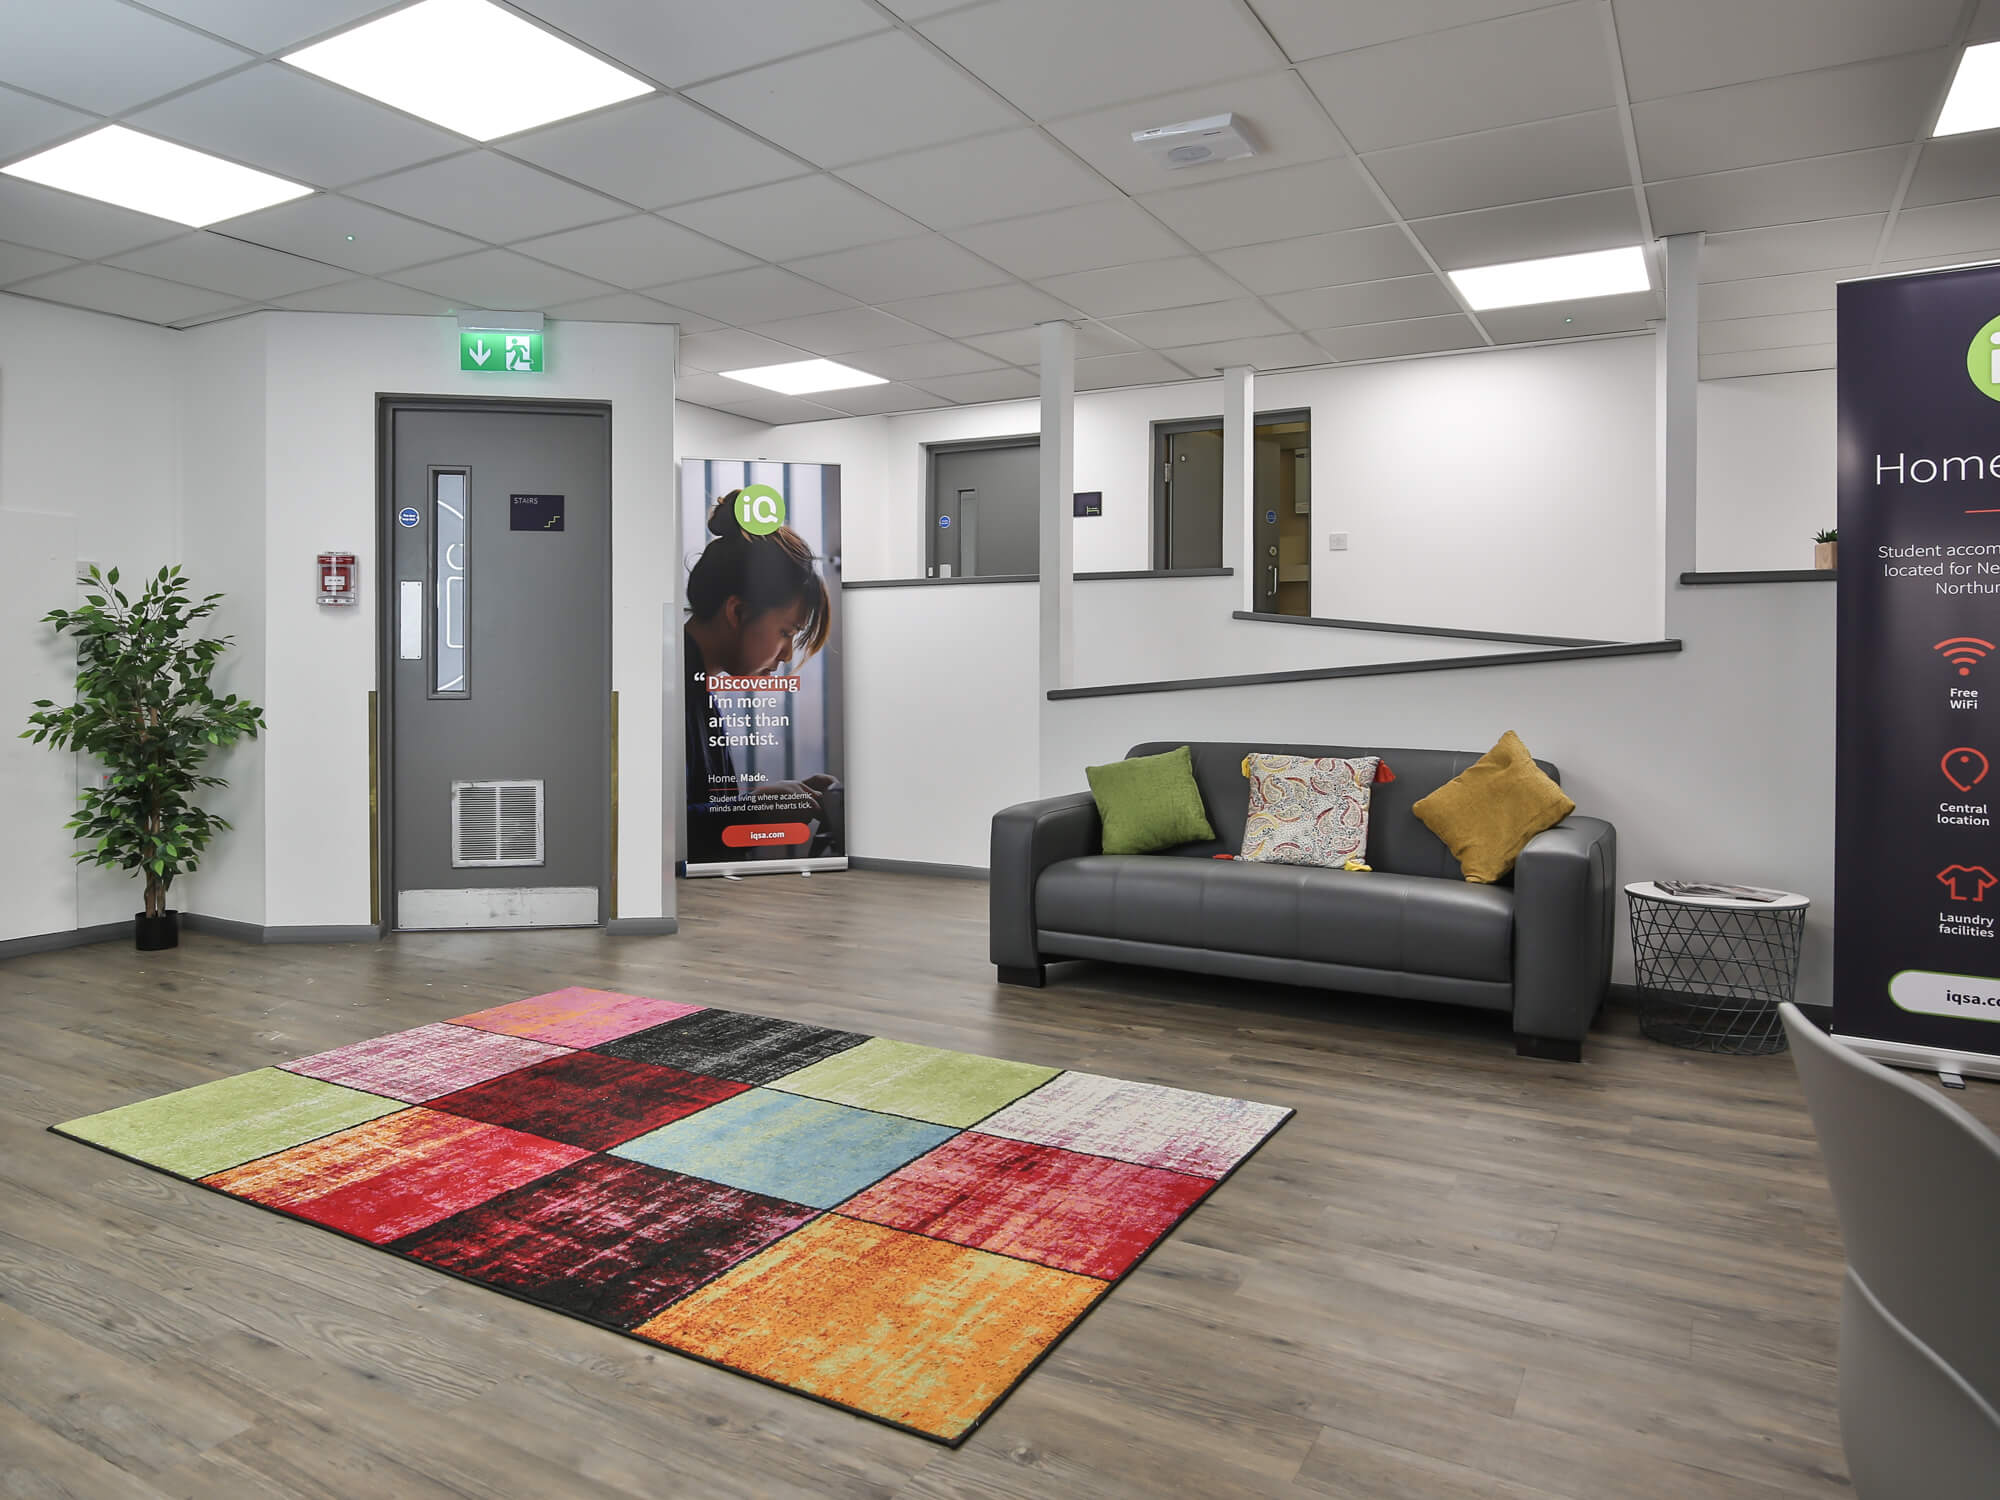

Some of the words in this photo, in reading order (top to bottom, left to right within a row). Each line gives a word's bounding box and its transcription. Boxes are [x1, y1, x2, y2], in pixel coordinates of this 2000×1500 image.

[743, 495, 778, 523] iQ
[1878, 544, 1941, 558] Student
[1884, 562, 1943, 577] located
[1949, 561, 1972, 575] for
[1950, 688, 1978, 697] Free
[737, 697, 777, 708] more
[1950, 699, 1978, 709] WiFi
[709, 713, 751, 727] artist
[755, 712, 789, 726] than
[709, 732, 779, 747] scientist.
[740, 773, 769, 782] Made.
[709, 795, 737, 803] Student
[738, 793, 756, 803] living
[757, 793, 779, 801] where
[780, 791, 812, 800] academic
[709, 804, 731, 813] minds
[733, 803, 746, 812] and
[747, 802, 774, 811] creative
[775, 801, 797, 810] hearts
[798, 801, 812, 809] tick.
[1940, 802, 1987, 814] Central
[1937, 814, 1990, 826] location
[750, 831, 785, 841] iqsa.com
[1940, 912, 1994, 928] Laundry
[1939, 924, 1994, 938] facilities
